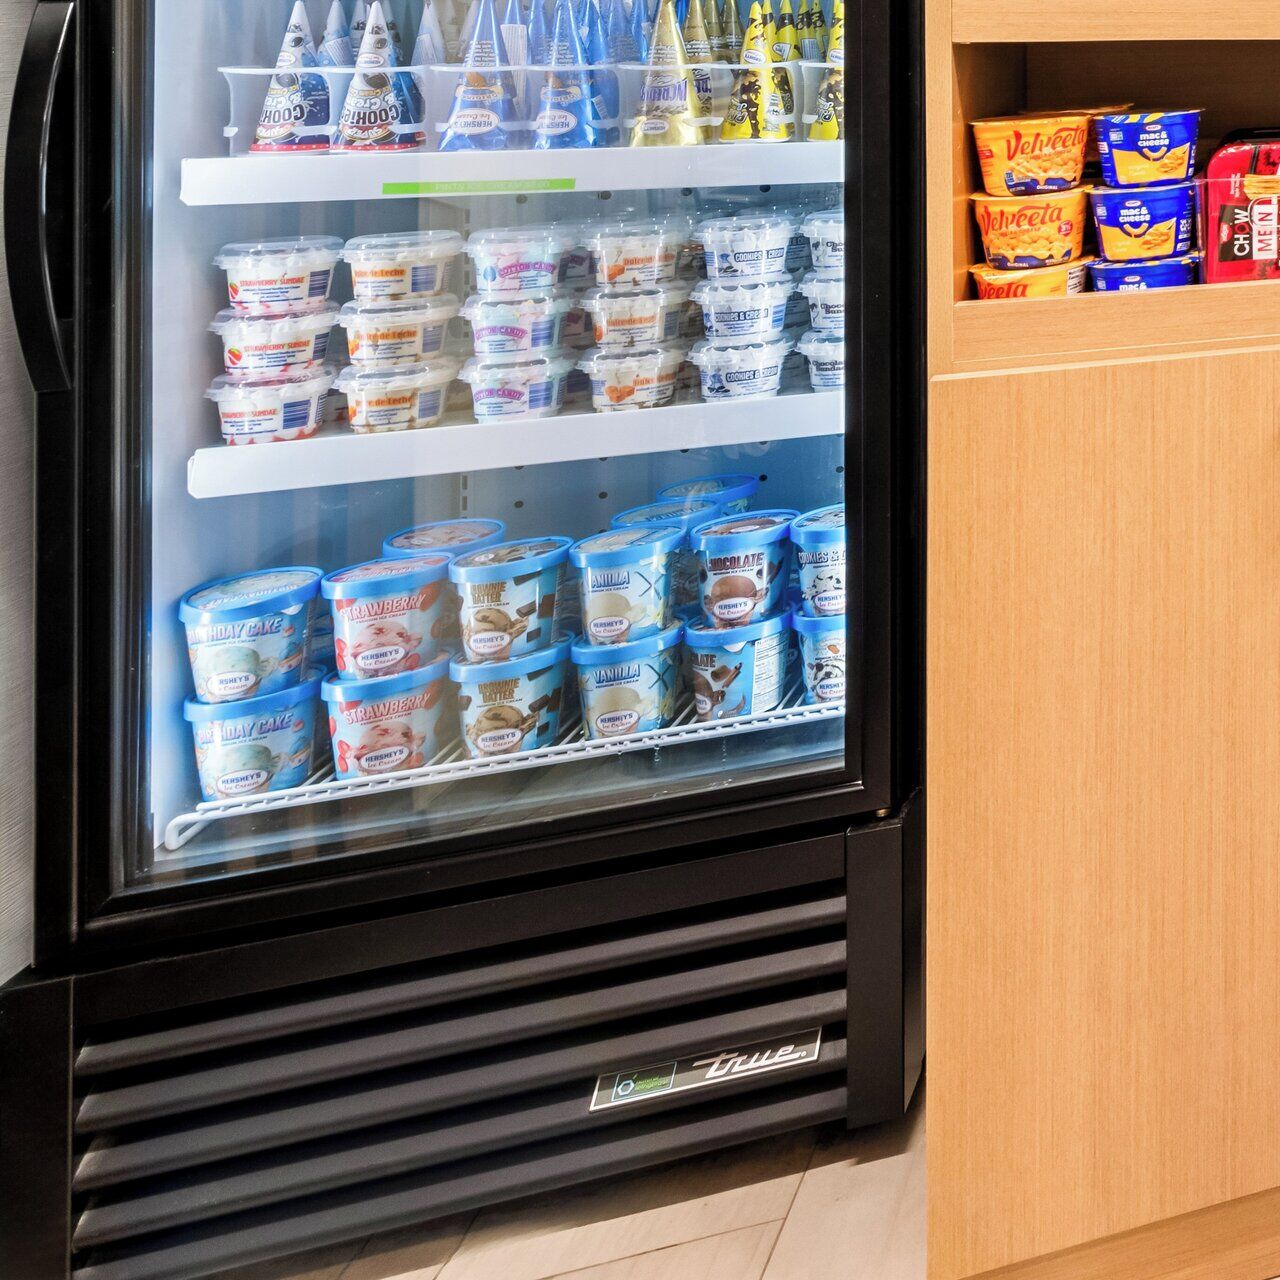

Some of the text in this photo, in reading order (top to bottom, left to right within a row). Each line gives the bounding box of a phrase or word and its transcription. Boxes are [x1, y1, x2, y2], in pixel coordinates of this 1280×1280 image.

[1006, 126, 1085, 162] Velveeta
[982, 203, 1063, 235] Velveeta
[1233, 209, 1251, 256] CHOW
[1258, 210, 1273, 252] MEIN
[734, 250, 763, 263] COOKIES
[240, 276, 305, 288] STRAWBERRY SUNDAE
[715, 310, 738, 321] COOKIES
[244, 340, 310, 352] STRAWBERRY SUNDAE
[726, 371, 753, 382] COOKIES
[830, 550, 839, 561] &
[341, 592, 426, 621] STRAWBERRY
[718, 600, 748, 610] HERSHEY'S
[246, 618, 283, 637] CAKE
[361, 648, 400, 661] HERSHEY'S
[375, 654, 399, 665] Cream
[592, 664, 640, 684] VANILLA
[343, 692, 431, 725] STRAWBERRY
[256, 713, 292, 733] CAKE
[600, 711, 633, 724] HERSHEY'S
[365, 748, 404, 763] HERSHEY'S
[379, 756, 403, 767] Cream
[221, 772, 262, 786] HERSHEY'S
